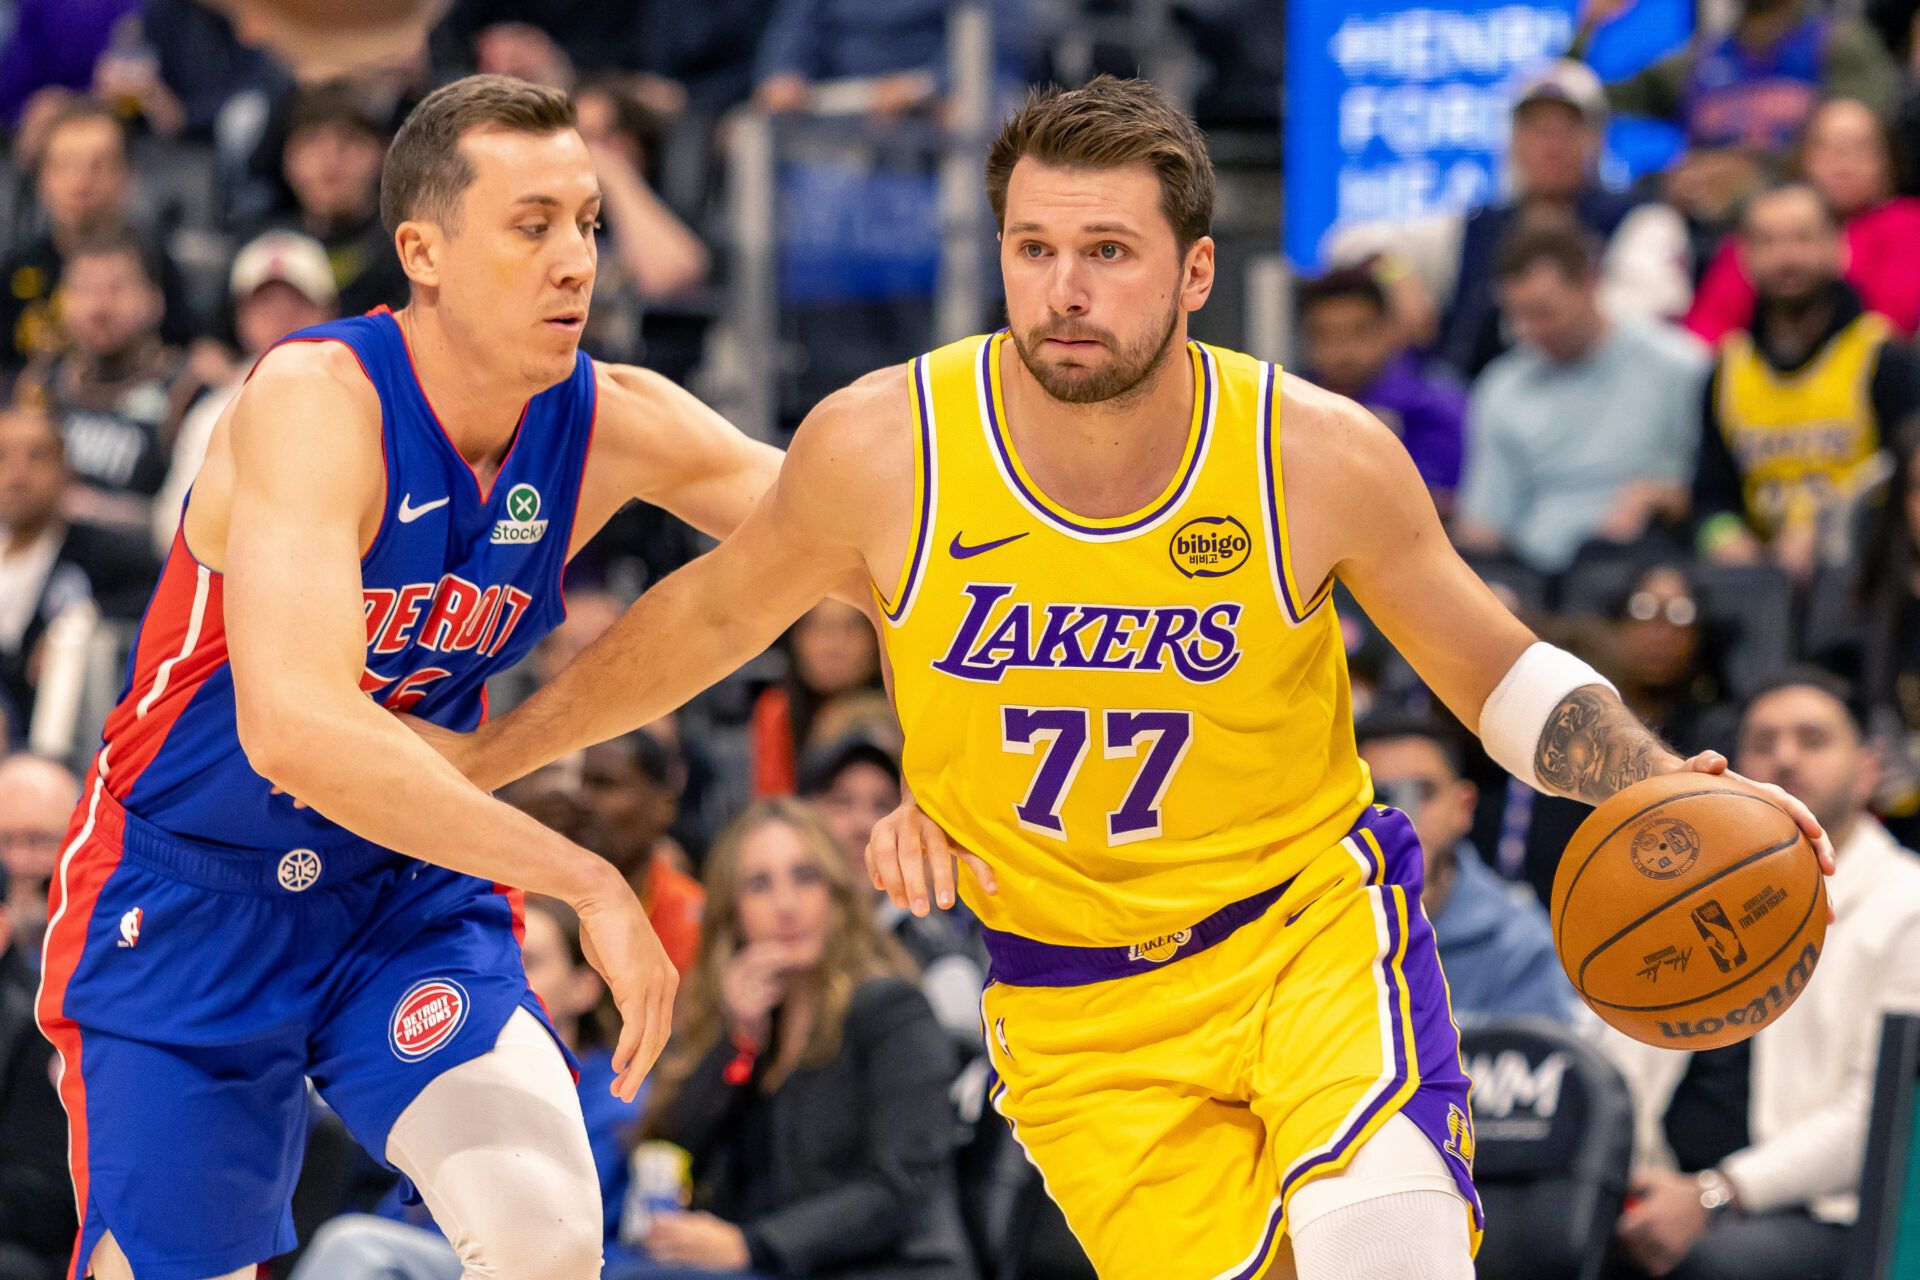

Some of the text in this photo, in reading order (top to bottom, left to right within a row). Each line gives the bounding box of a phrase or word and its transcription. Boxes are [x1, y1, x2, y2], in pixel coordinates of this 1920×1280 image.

[1177, 532, 1246, 559] bibigo
[1189, 554, 1218, 565] 비비고
[363, 573, 532, 657] DEROIT
[930, 582, 1245, 685] LAKERS
[1000, 704, 1194, 848] 77
[401, 995, 449, 1030] DETROIT
[1655, 941, 1819, 1038] Wilson
[403, 1006, 452, 1042] PISTONS
